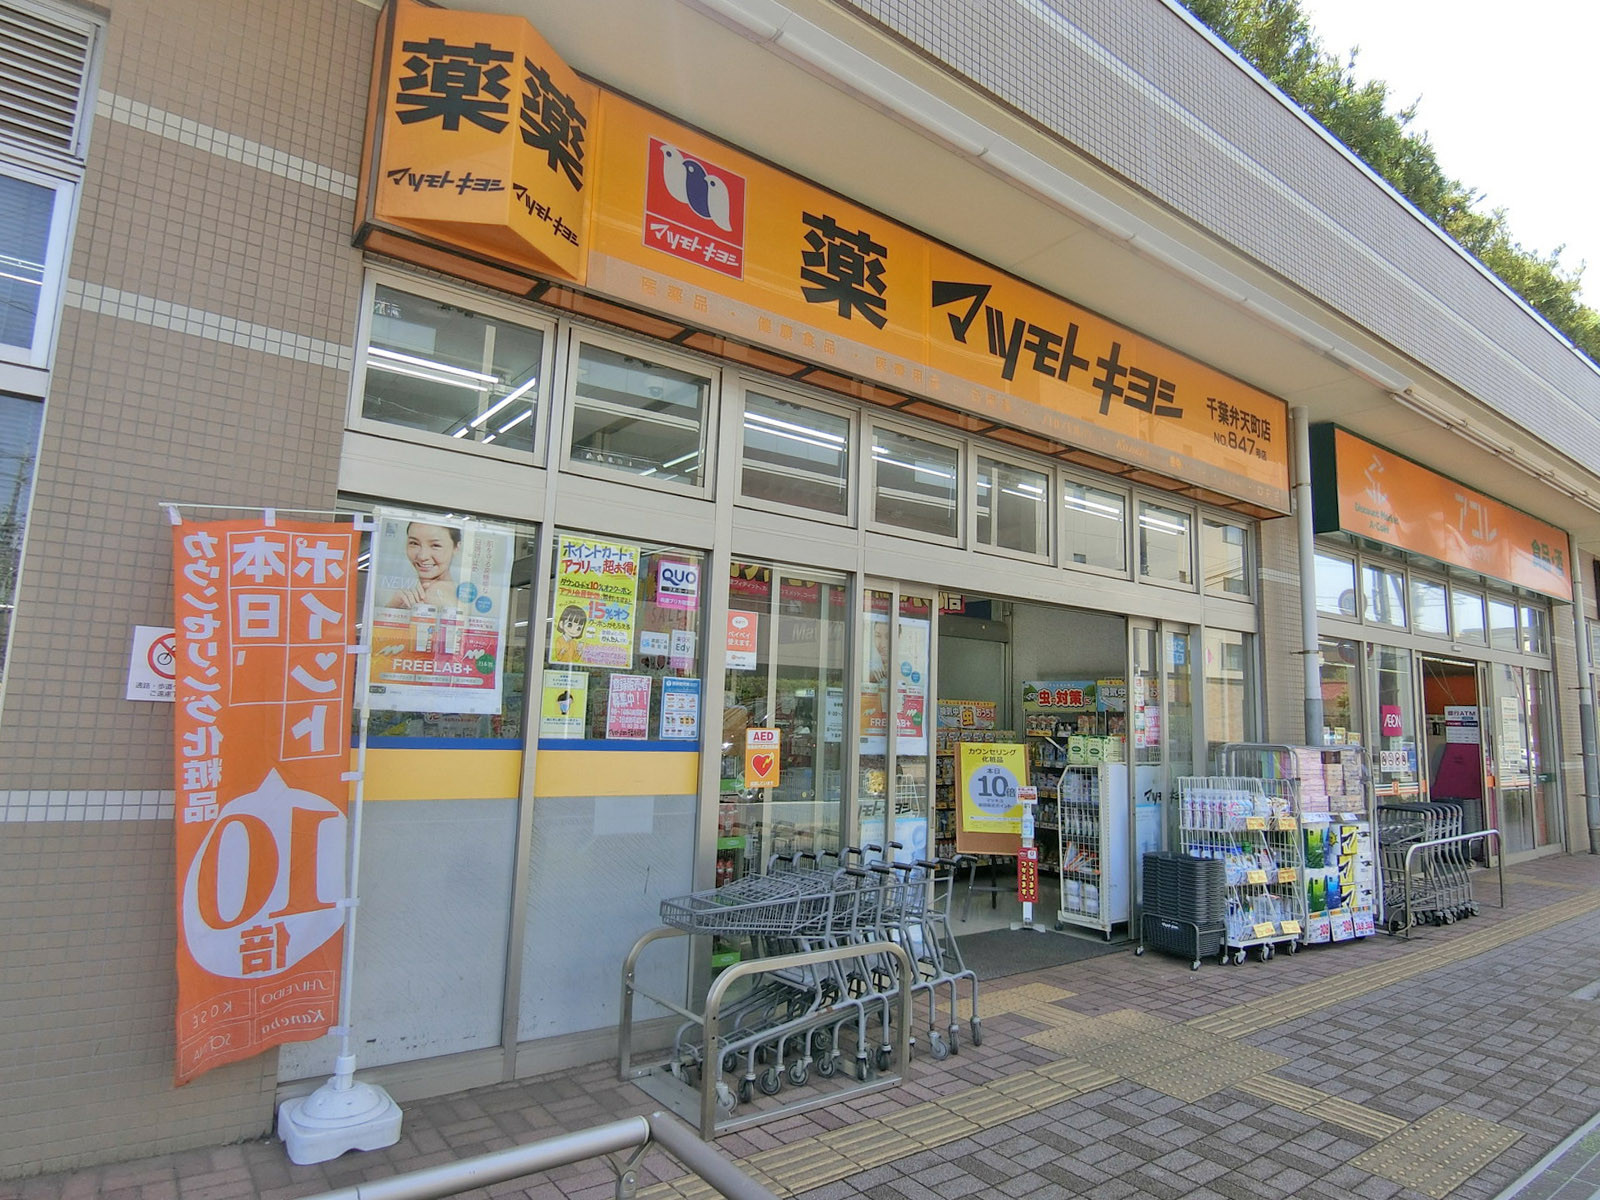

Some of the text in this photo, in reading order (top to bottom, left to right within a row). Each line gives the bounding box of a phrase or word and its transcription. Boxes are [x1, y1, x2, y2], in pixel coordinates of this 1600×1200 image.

[395, 38, 513, 134] 薬
[519, 55, 587, 193] 薬
[800, 210, 888, 330] 薬
[931, 280, 1184, 420] マツモトキヨシ
[1206, 396, 1272, 443] 千葉弁天町店
[661, 568, 697, 587] QUO
[675, 643, 691, 653] Edy
[392, 658, 473, 675] FREELAB+
[1383, 713, 1402, 728] AEON
[752, 731, 774, 742] AED
[968, 748, 1017, 756] カウンセリング
